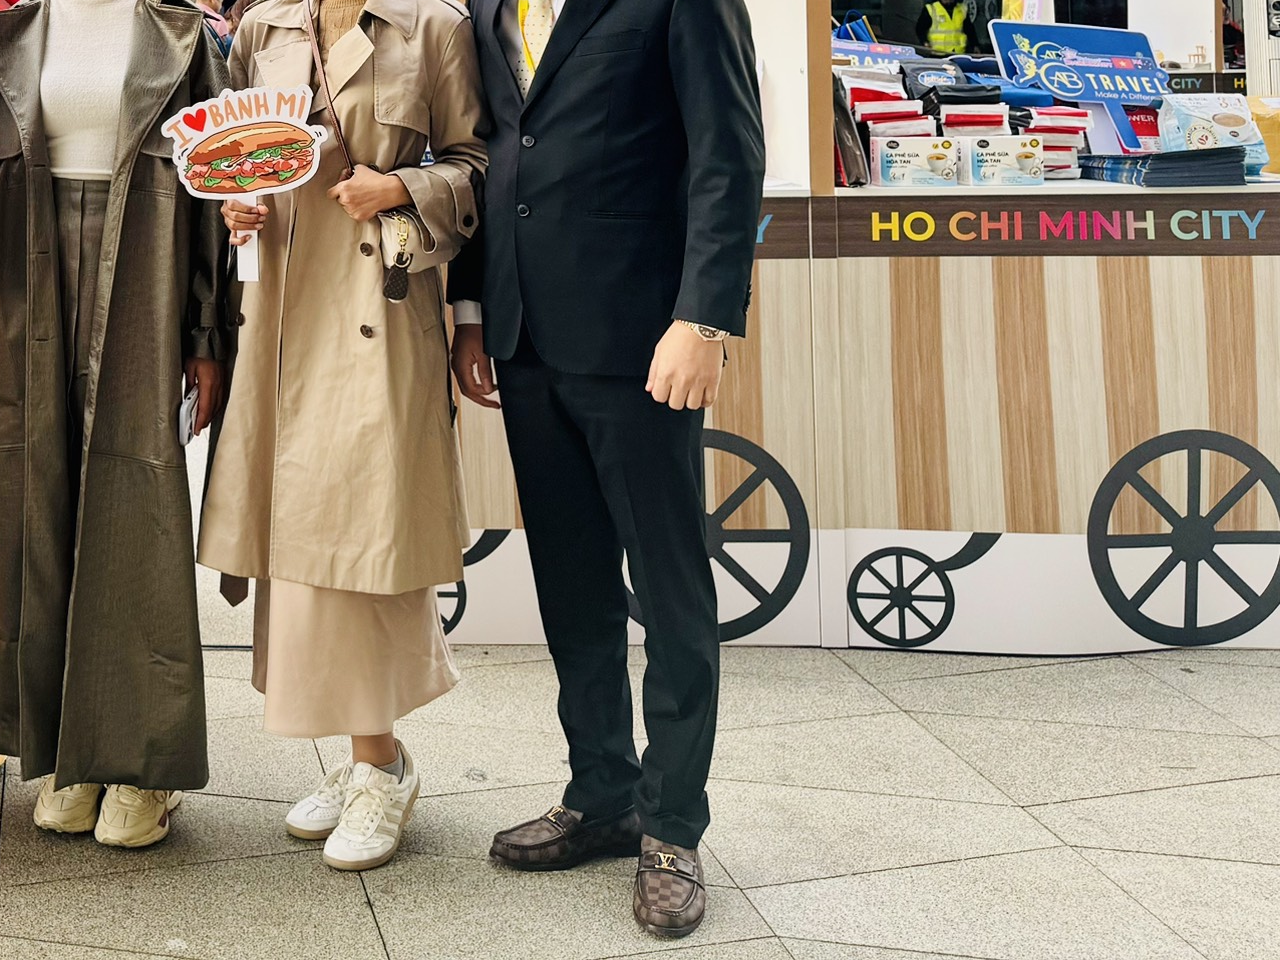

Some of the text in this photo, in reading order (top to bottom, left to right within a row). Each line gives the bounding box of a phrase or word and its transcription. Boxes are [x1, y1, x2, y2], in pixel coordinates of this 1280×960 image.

[1085, 73, 1169, 94] TRAVEL
[1171, 78, 1247, 89] CITY H
[166, 90, 307, 149] I BÁNH MÌ
[871, 209, 1266, 241] HO CHI MINH CITY
